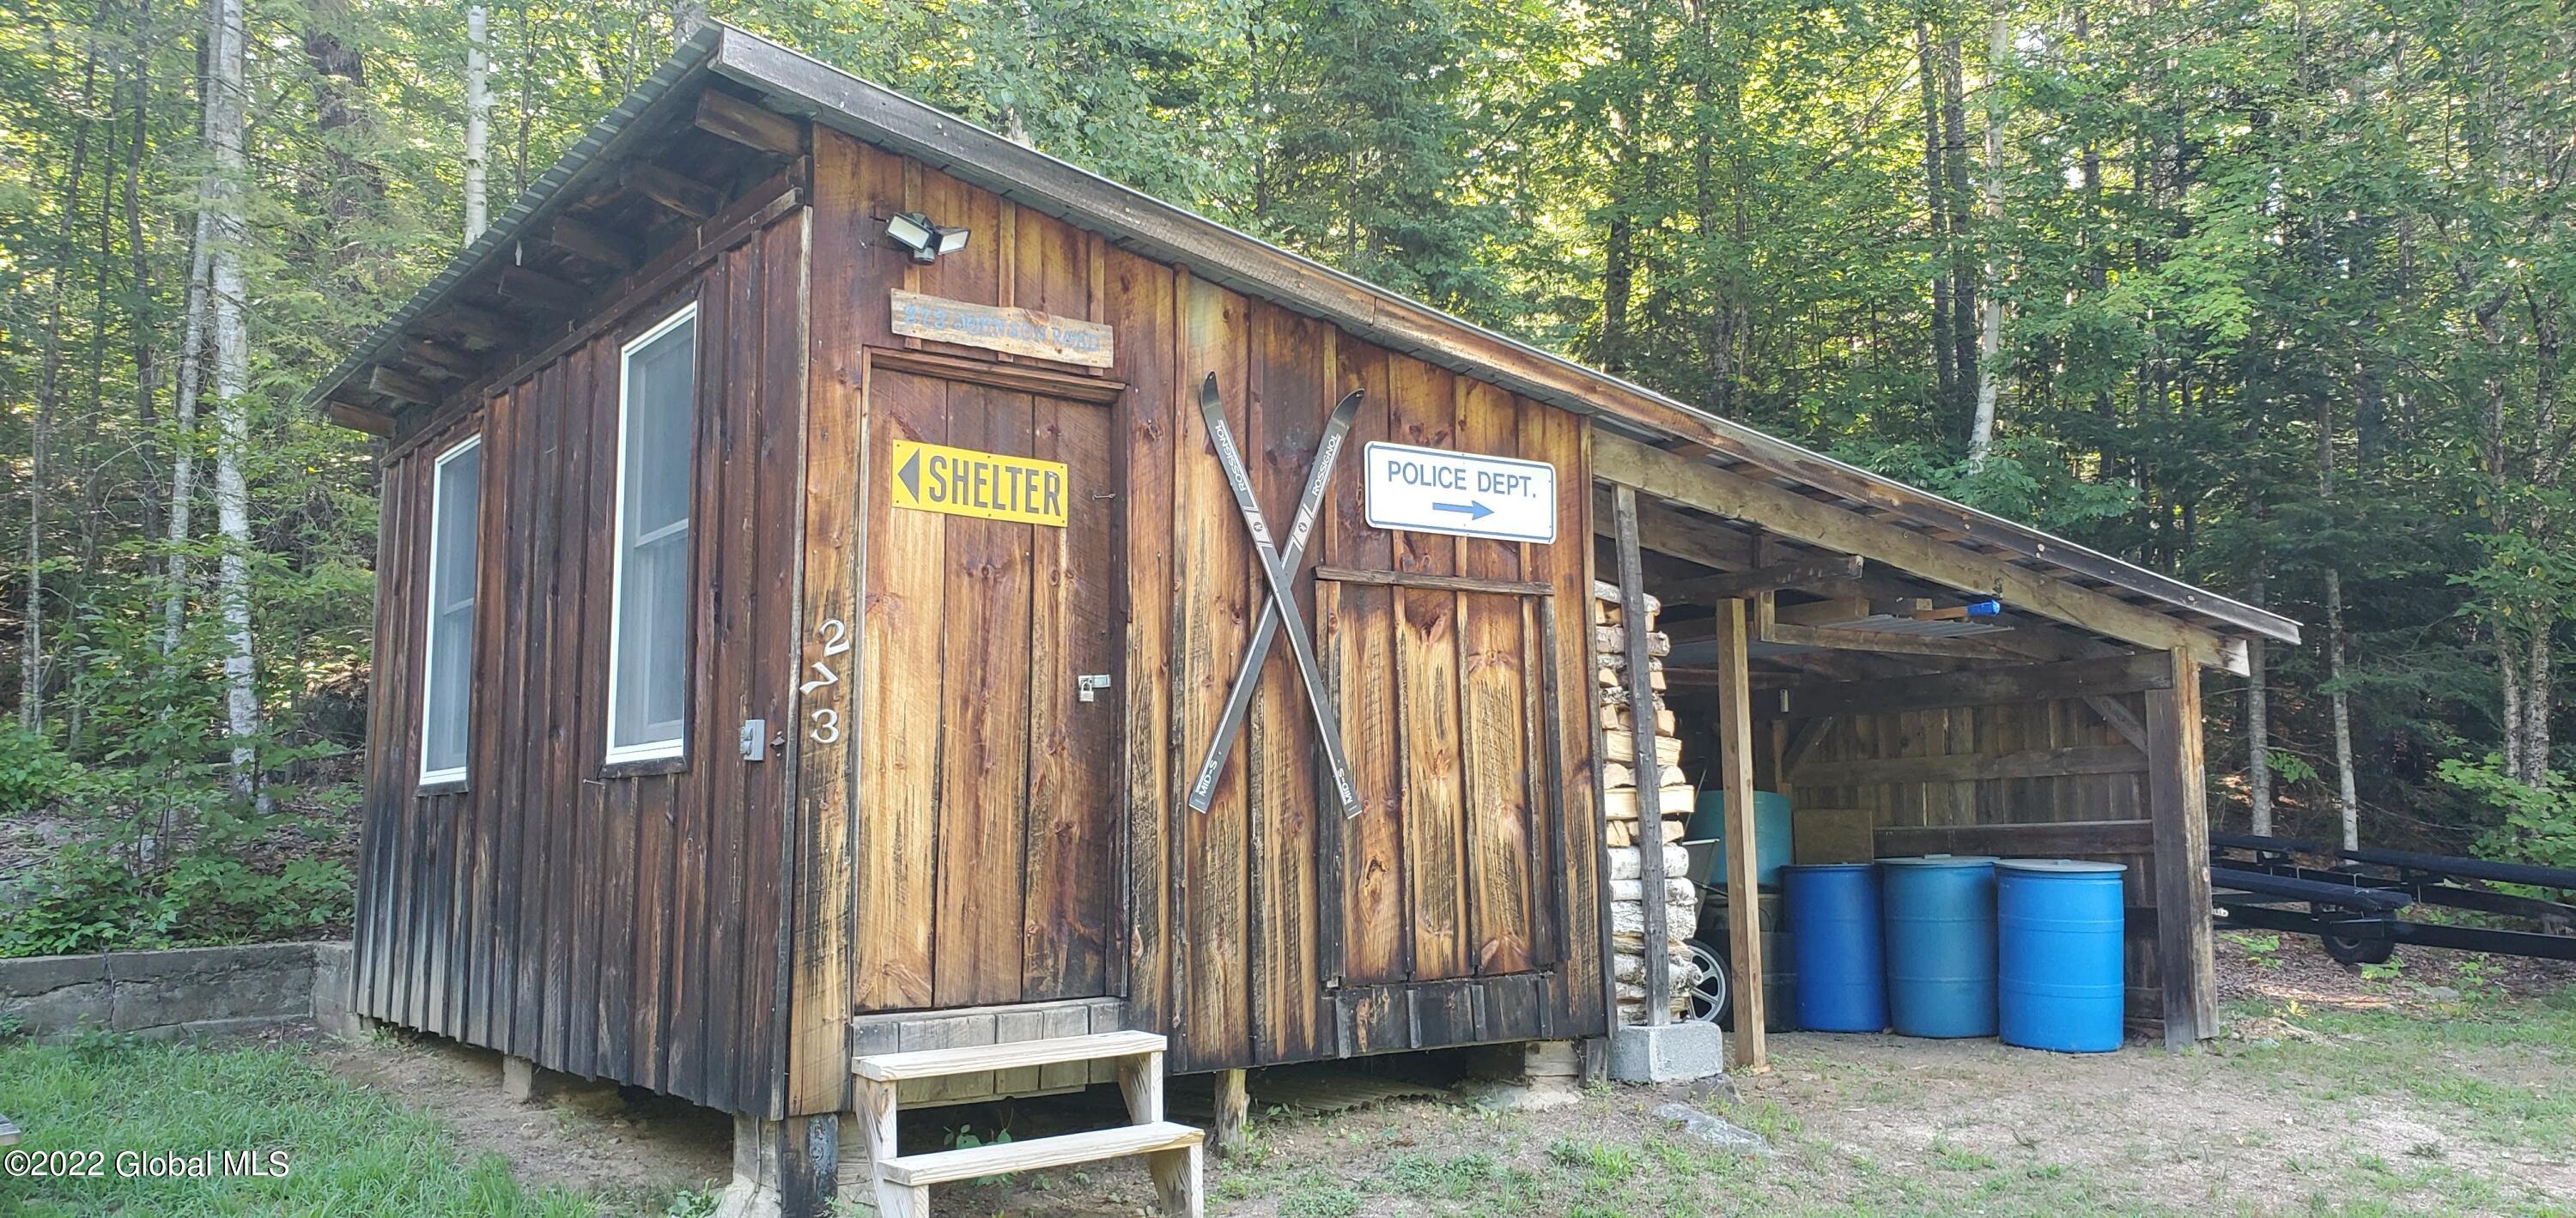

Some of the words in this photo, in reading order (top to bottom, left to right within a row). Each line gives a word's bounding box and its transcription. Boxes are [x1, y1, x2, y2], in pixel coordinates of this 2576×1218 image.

[903, 302, 946, 330] 273
[1215, 419, 1247, 493] ROSSIGNOL
[1311, 433, 1341, 496] ROSSIGNOL
[928, 455, 1061, 517] SHELTER
[1388, 460, 1467, 490] POLICE
[1478, 470, 1536, 498] DEPT.
[1198, 759, 1218, 797] MID-S
[1337, 767, 1354, 804] MID-S
